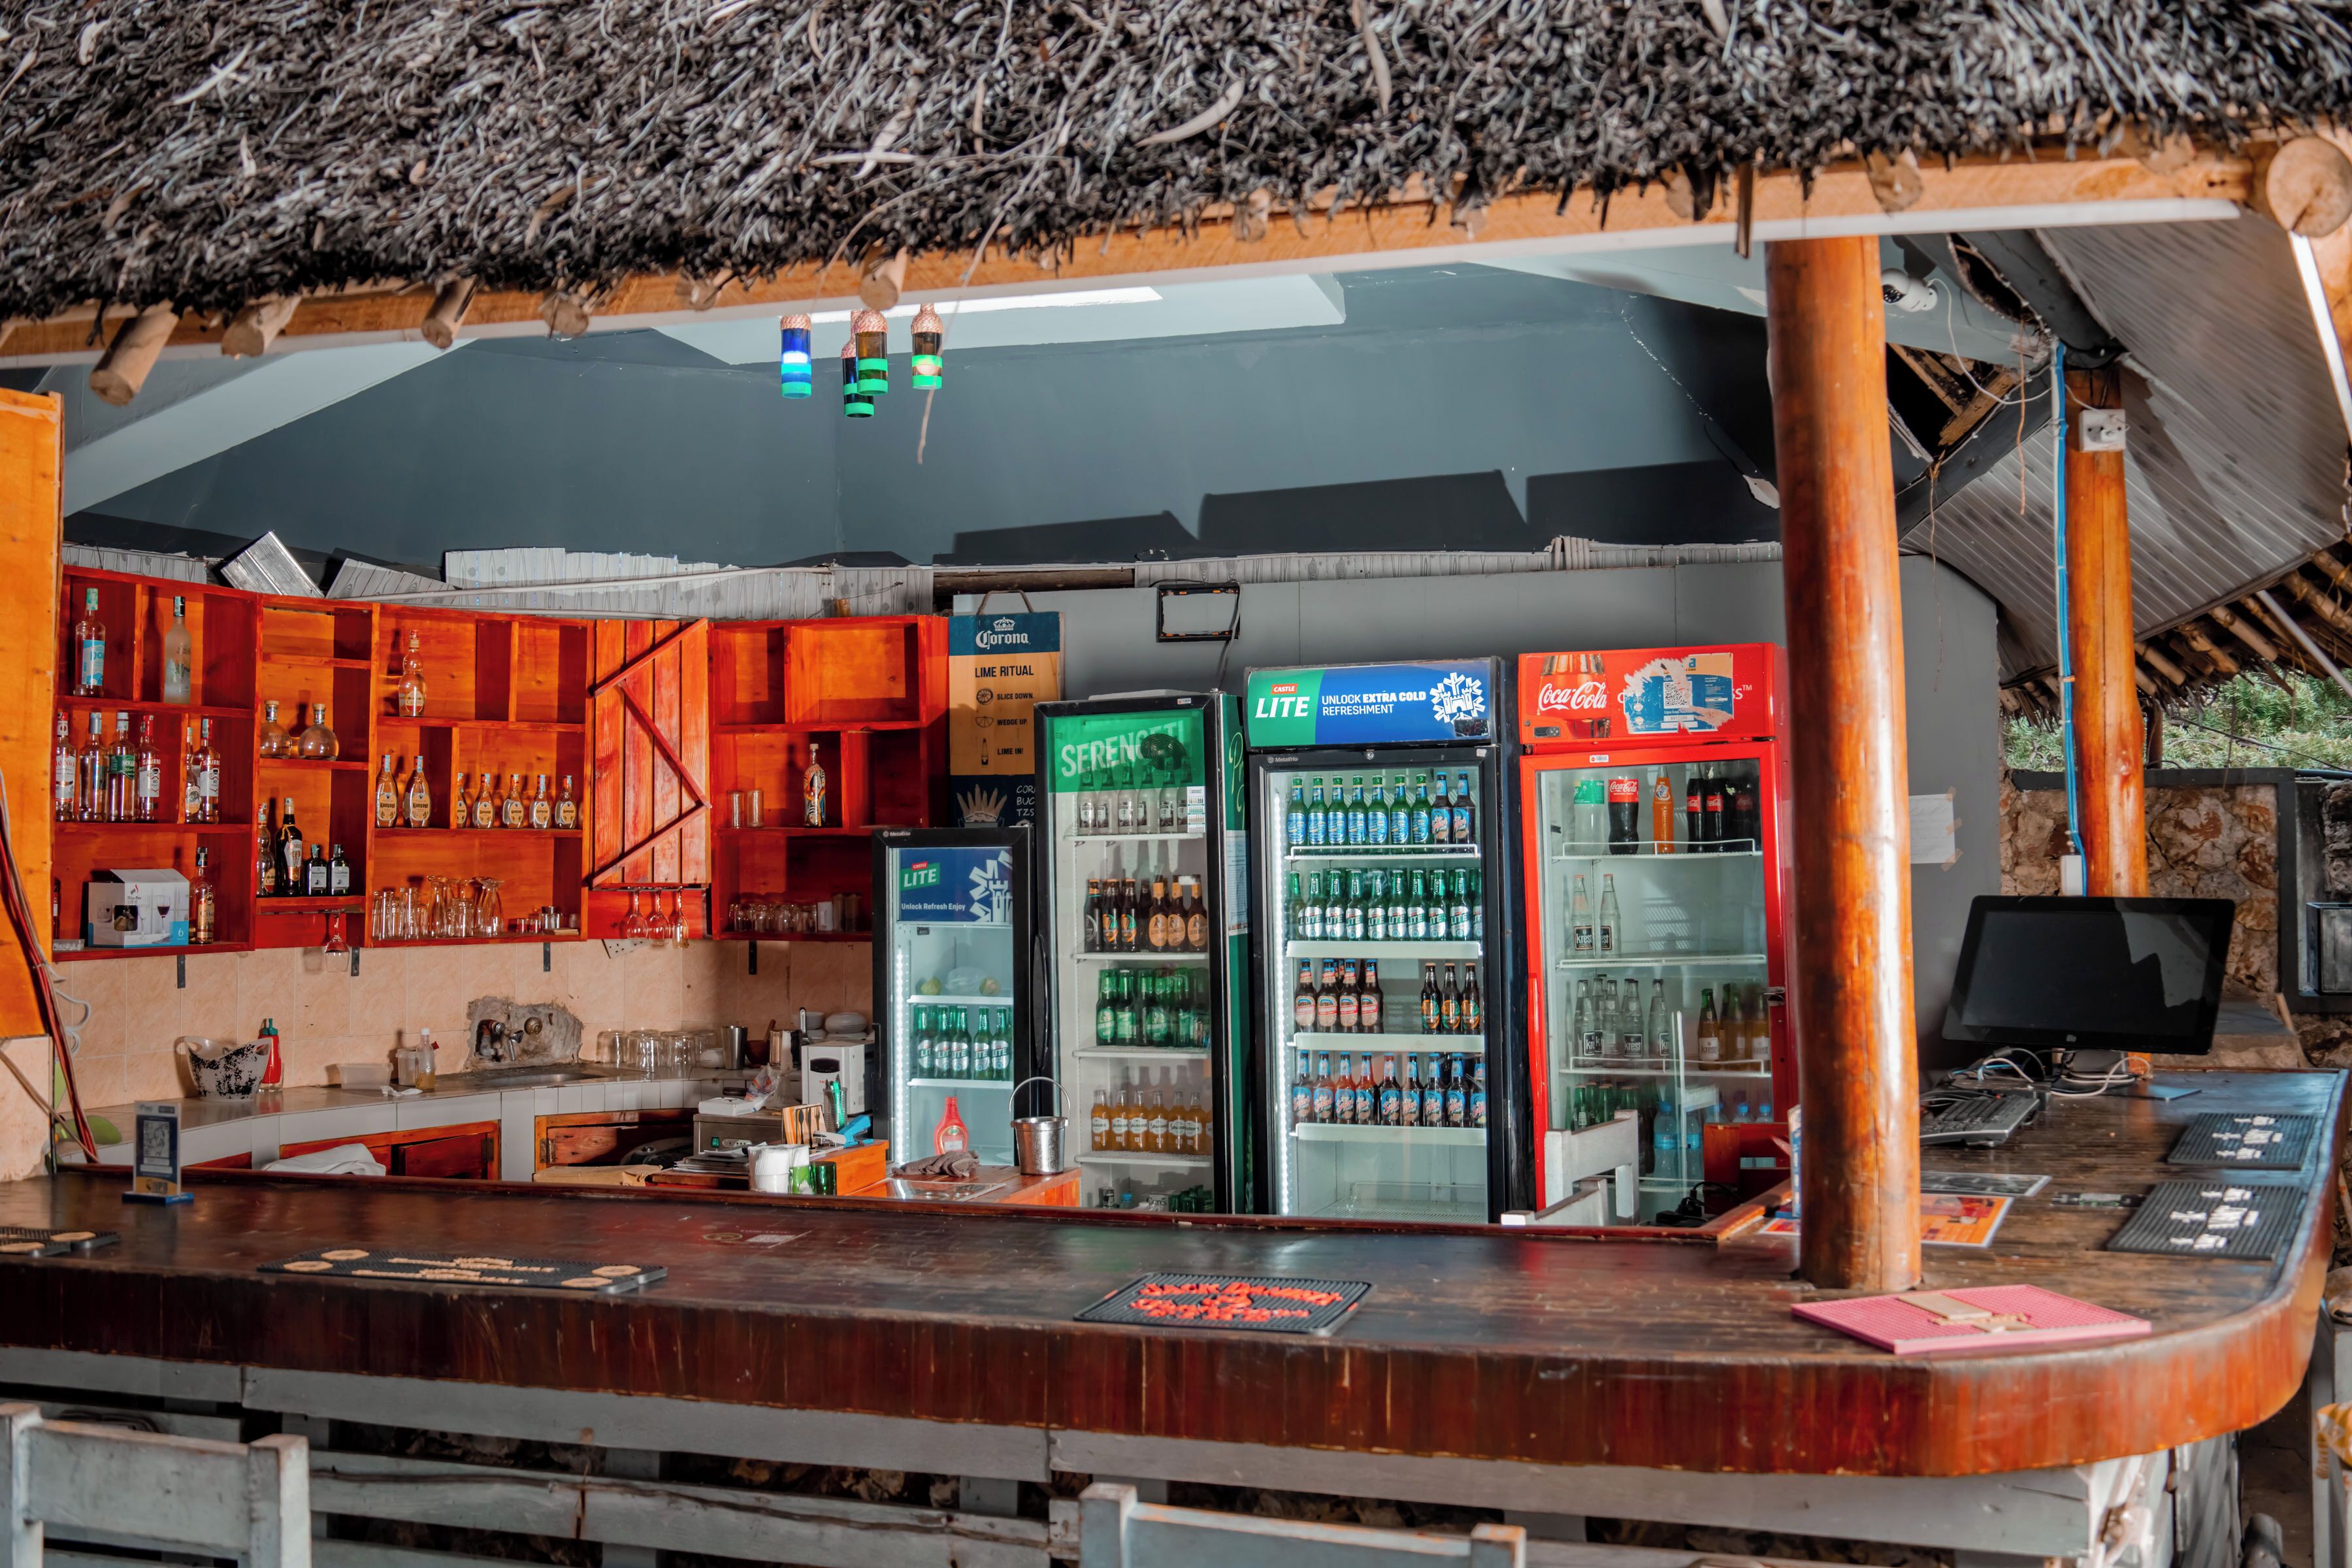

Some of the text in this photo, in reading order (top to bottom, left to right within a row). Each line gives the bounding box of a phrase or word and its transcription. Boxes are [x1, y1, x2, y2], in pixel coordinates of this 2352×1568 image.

[975, 630, 1029, 650] Corona
[975, 664, 1034, 678] LIME RITUAL
[1322, 691, 1426, 705] UNLOCK EXTRA COLD
[1538, 681, 1607, 711] Coca-Cola
[1254, 696, 1310, 718] LITE
[1322, 704, 1394, 716] REFRESHMENT
[1610, 781, 1637, 792] Coca-Cola
[1017, 796, 1035, 806] BUC
[1016, 808, 1035, 817] TZS
[904, 868, 937, 887] LITE
[948, 903, 966, 911] Enjoy
[1429, 915, 1441, 924] ITE
[1450, 915, 1467, 924] LITE
[178, 928, 184, 937] 6
[1576, 933, 1592, 944] krest
